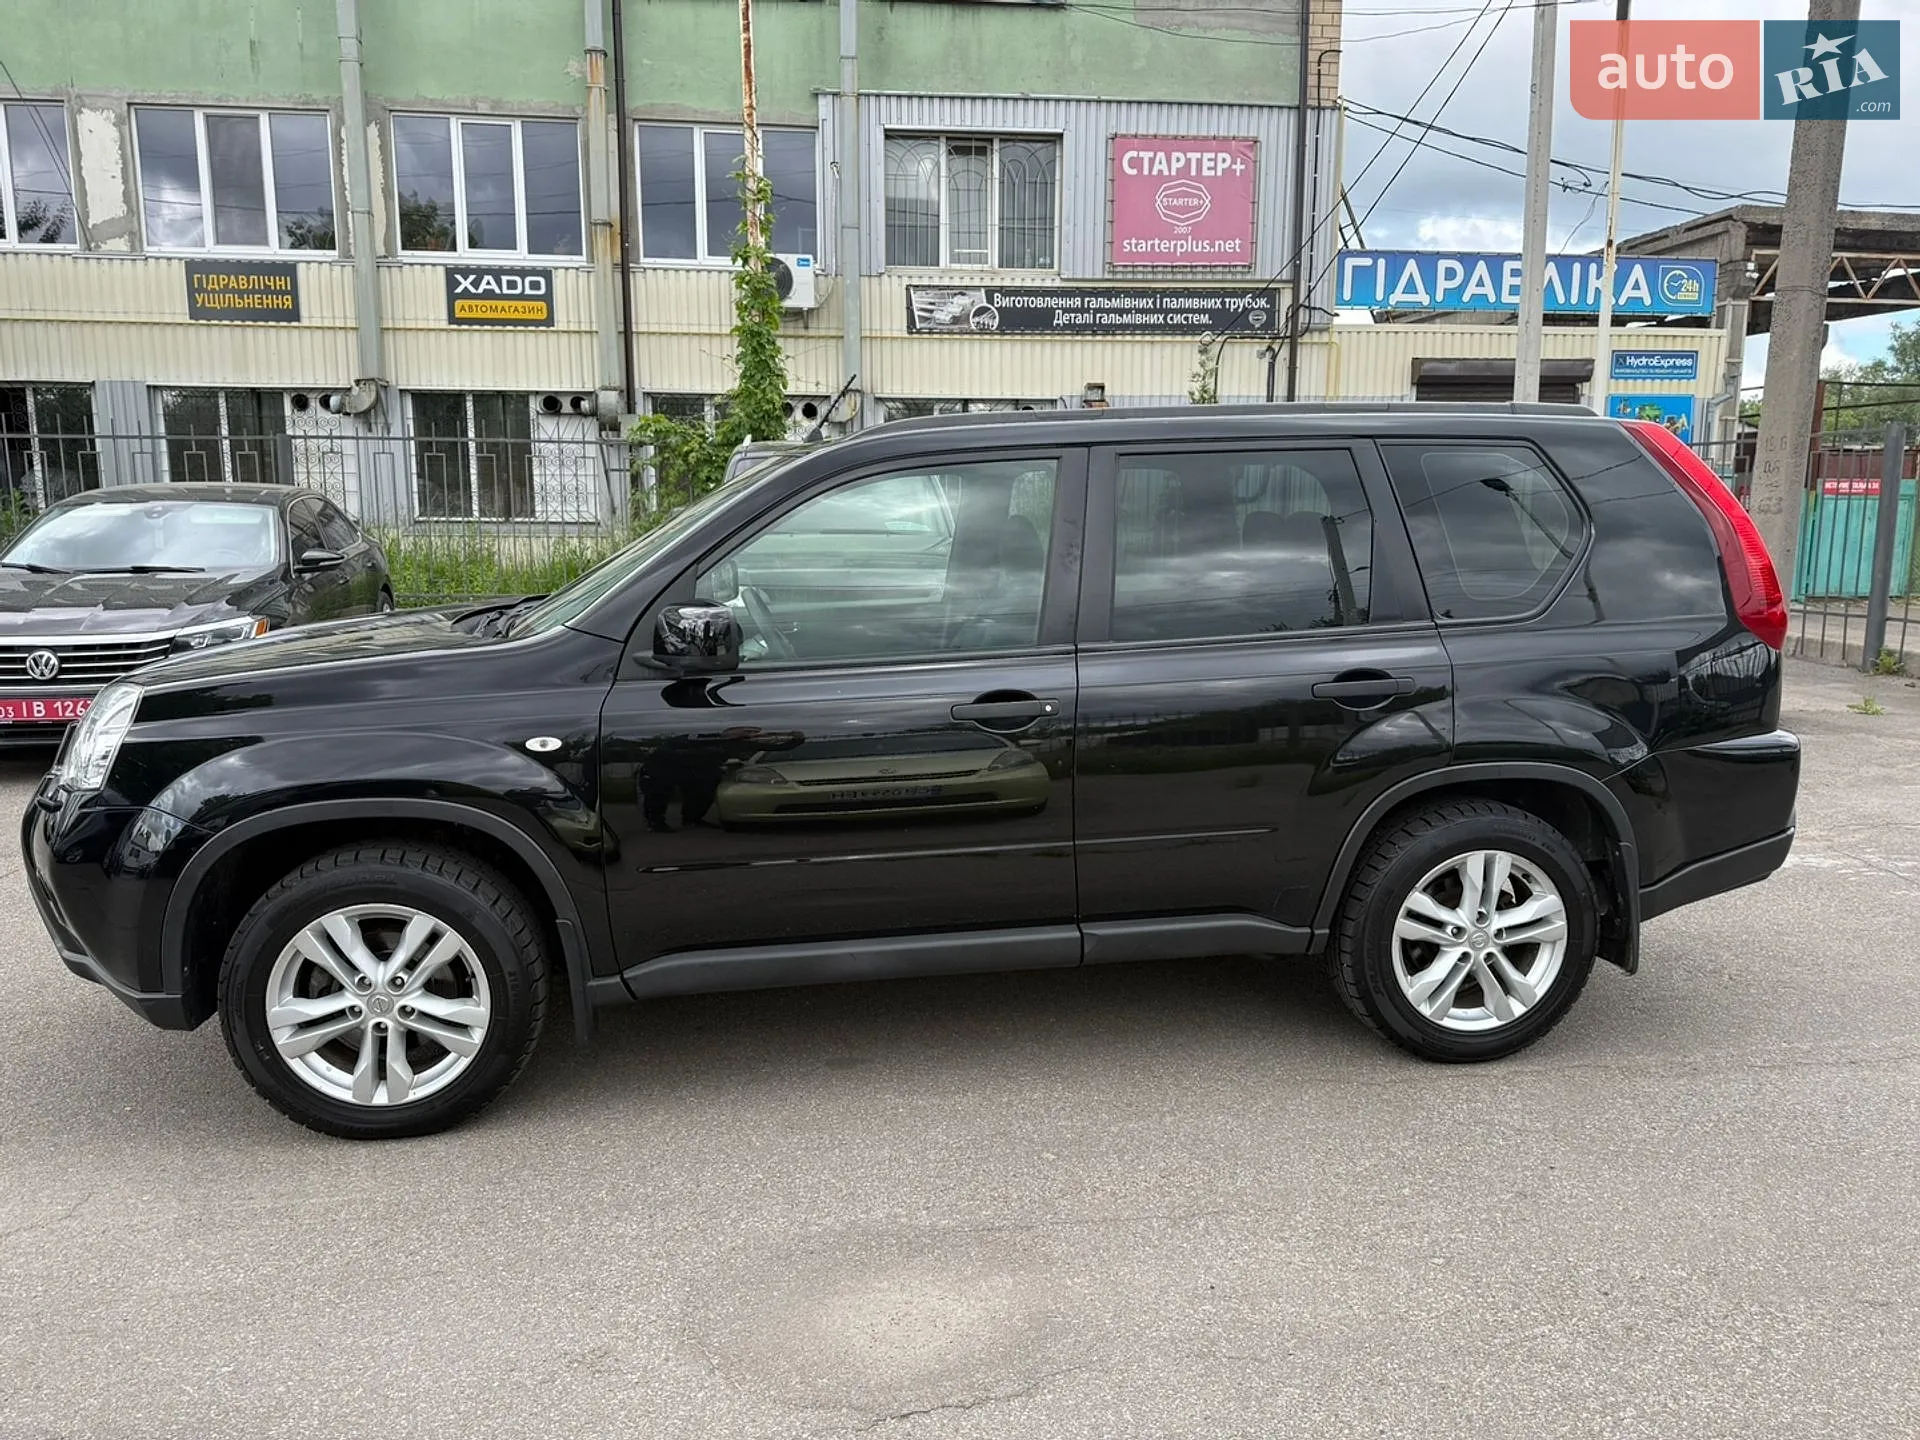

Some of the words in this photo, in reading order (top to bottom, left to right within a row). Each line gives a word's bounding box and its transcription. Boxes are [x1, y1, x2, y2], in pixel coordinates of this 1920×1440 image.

[1122, 150, 1245, 177] СТАРТЕР+
[1122, 235, 1241, 256] starterplus.net
[193, 274, 292, 291] ГІДРАВЛІЧНІ
[453, 274, 547, 295] XADO
[195, 293, 293, 310] УЩІЛЬНЕННЯ
[459, 304, 544, 315] АВТОМАГАЗИН
[993, 292, 1081, 308] Виготовлення
[1084, 294, 1154, 309] гальмівних
[1162, 296, 1222, 309] паливних
[1224, 293, 1271, 312] трубок.
[1053, 309, 1094, 327] Деталі
[1095, 310, 1165, 325] гальмівних
[1167, 313, 1213, 325] систем.
[1625, 355, 1694, 368] HydroExpress
[53, 700, 92, 717] 126
